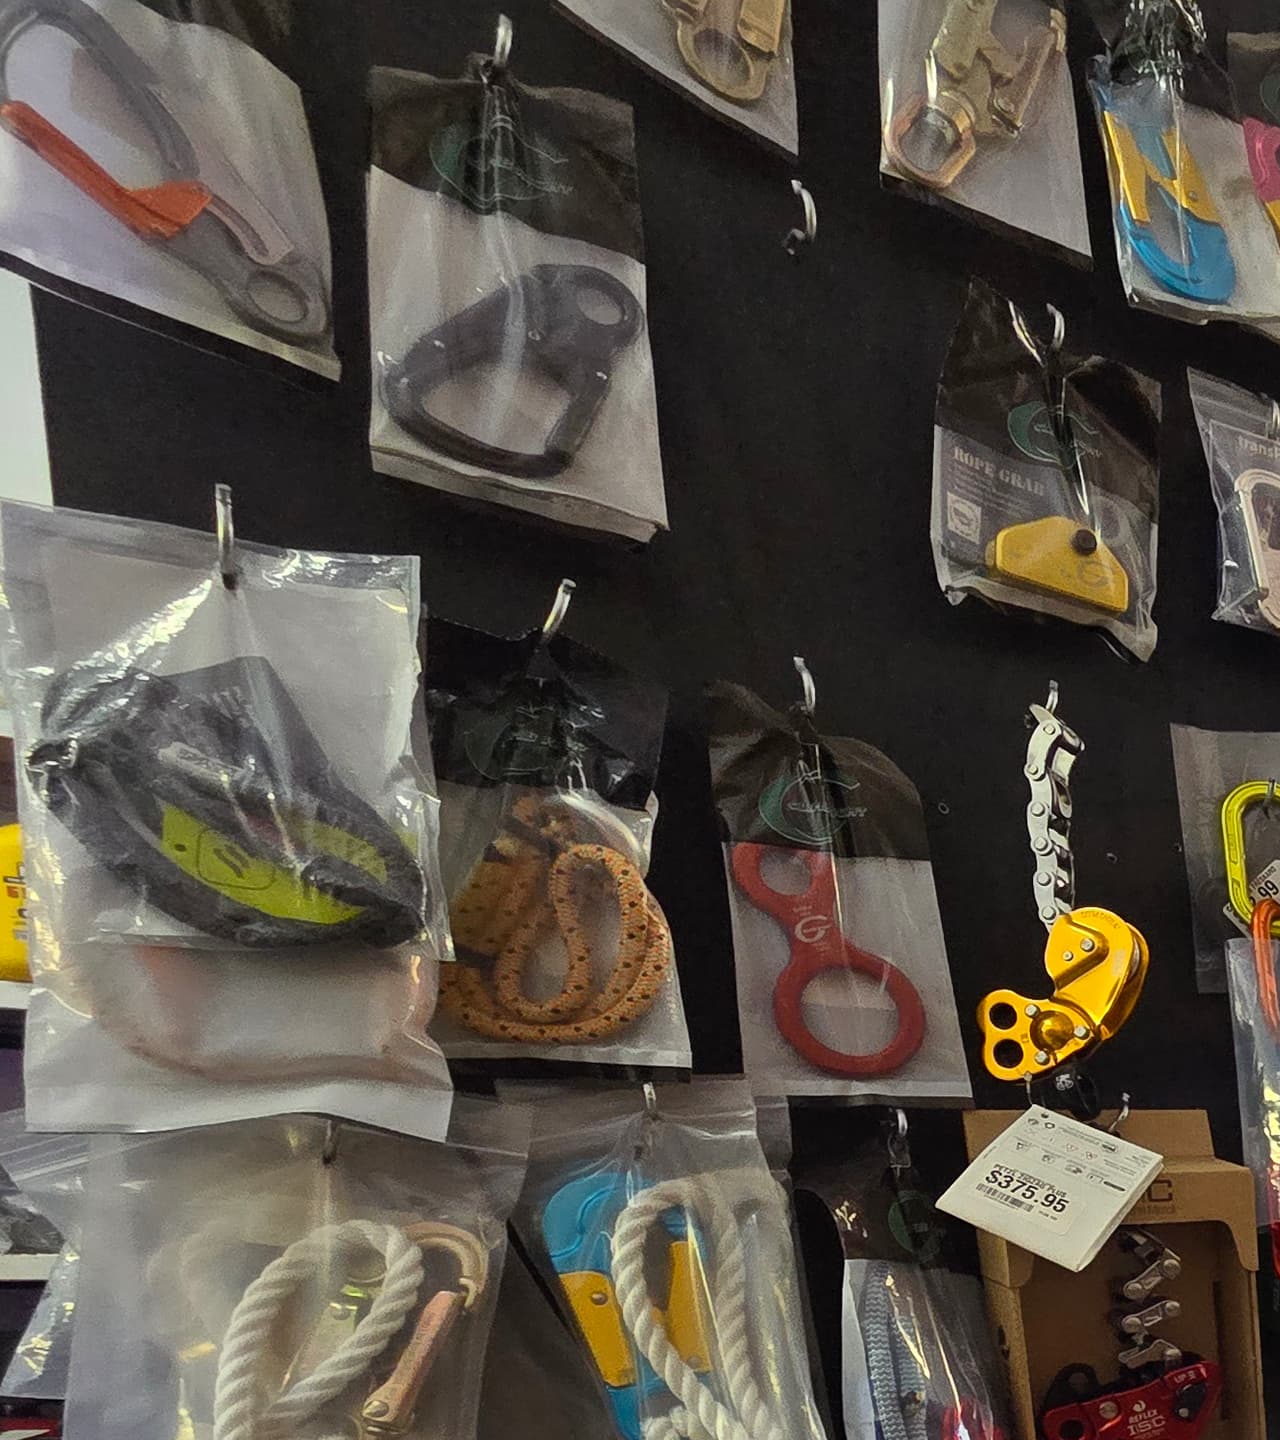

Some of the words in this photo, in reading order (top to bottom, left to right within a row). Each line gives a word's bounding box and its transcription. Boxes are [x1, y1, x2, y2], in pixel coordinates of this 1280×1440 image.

[954, 446, 996, 478] ROPE
[1000, 468, 1046, 497] GRAB
[984, 1169, 1070, 1214] $375.95
[1128, 1408, 1159, 1425] REFLEX
